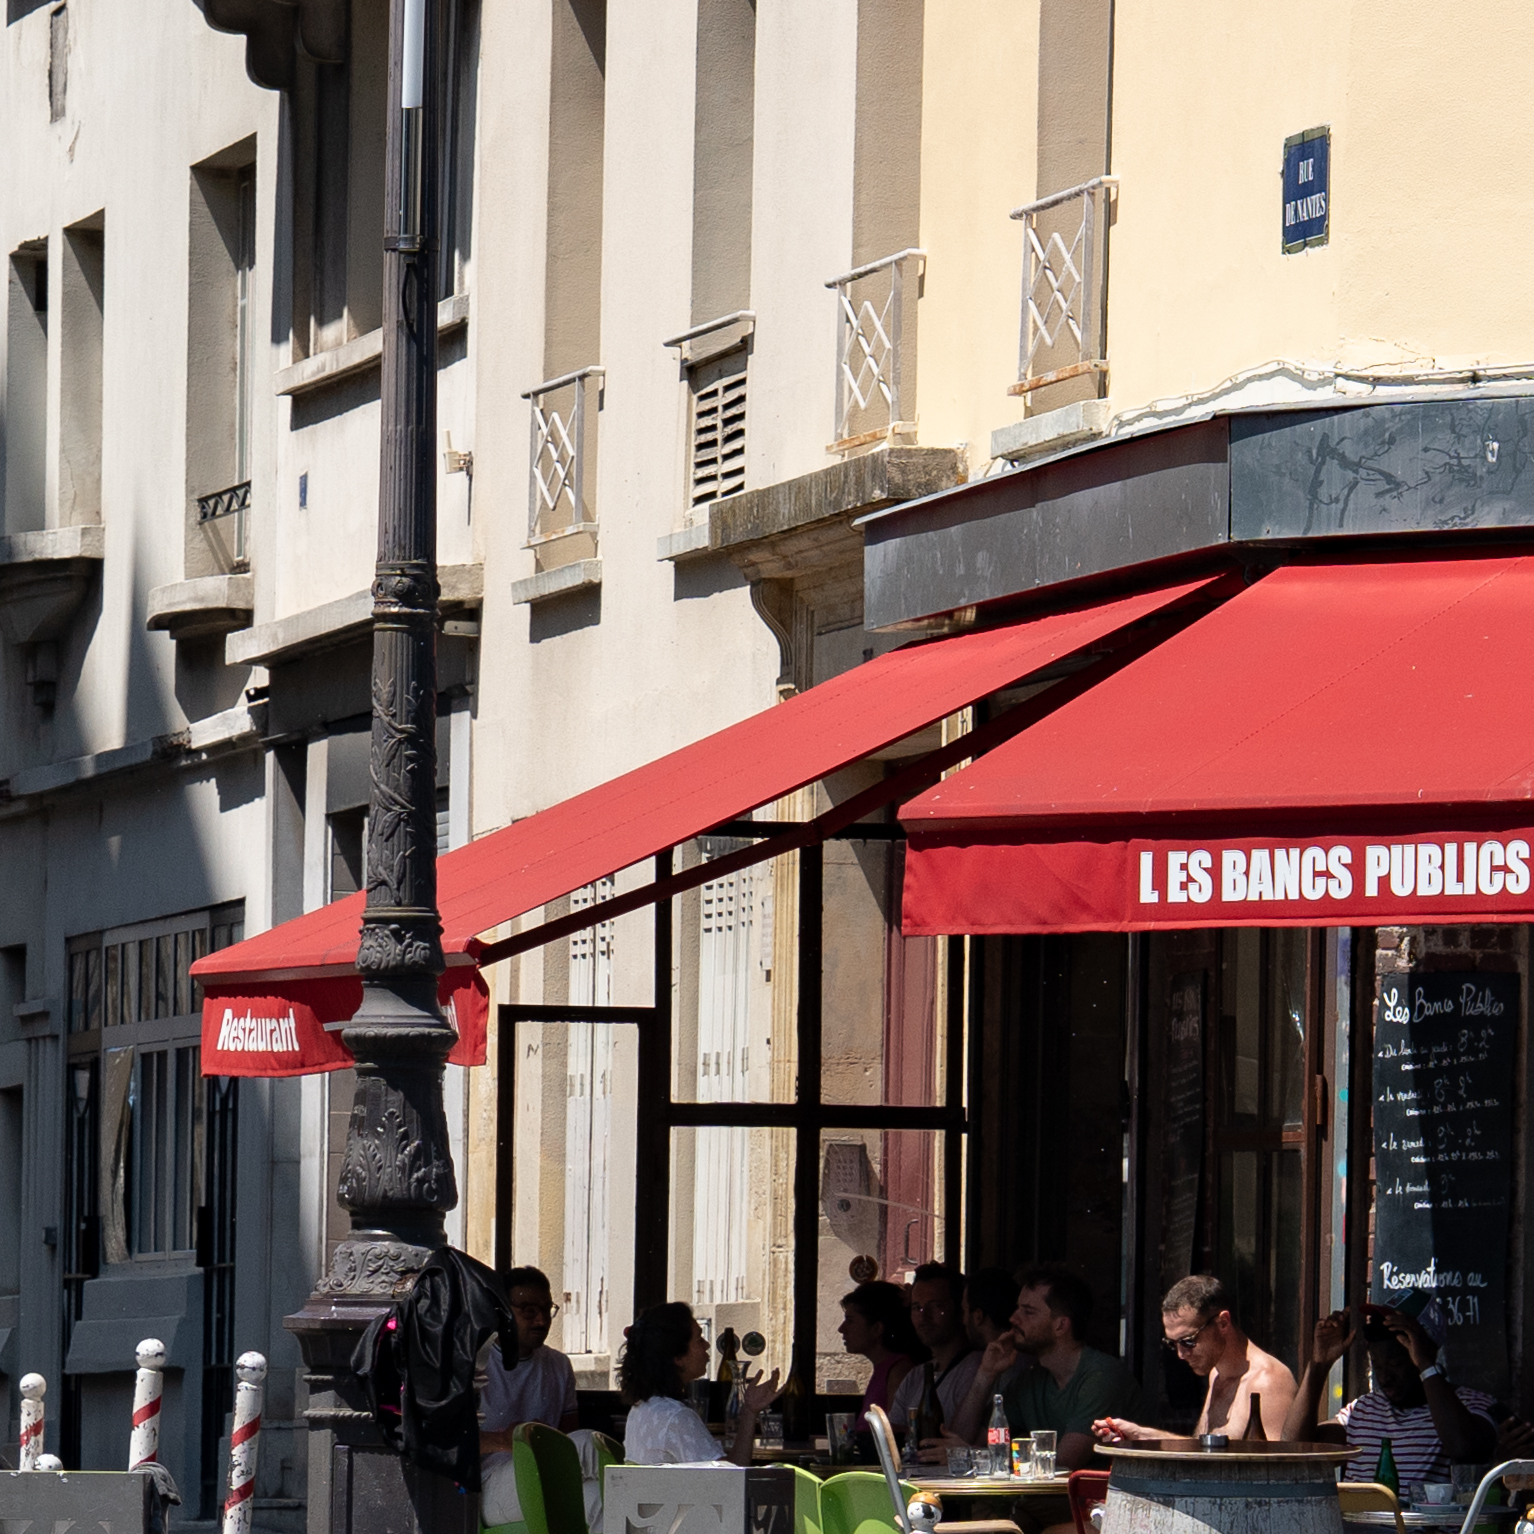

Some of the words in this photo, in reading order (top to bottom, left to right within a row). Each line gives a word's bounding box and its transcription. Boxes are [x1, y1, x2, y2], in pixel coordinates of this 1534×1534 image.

[1299, 158, 1314, 184] RUE
[1285, 202, 1295, 226] DE
[1297, 192, 1326, 222] NANTES
[1138, 848, 1215, 905] LES
[1221, 844, 1353, 903] BANCS
[1363, 838, 1532, 898] PUBLICS
[1382, 987, 1411, 1025] Les
[1412, 986, 1455, 1023] Bancs
[1459, 983, 1505, 1017] Publics
[216, 1007, 300, 1053] Restaurant
[1379, 1256, 1463, 1290] Réservations
[1466, 1271, 1489, 1289] au
[1445, 1295, 1464, 1326] 36
[1465, 1294, 1480, 1325] 71
